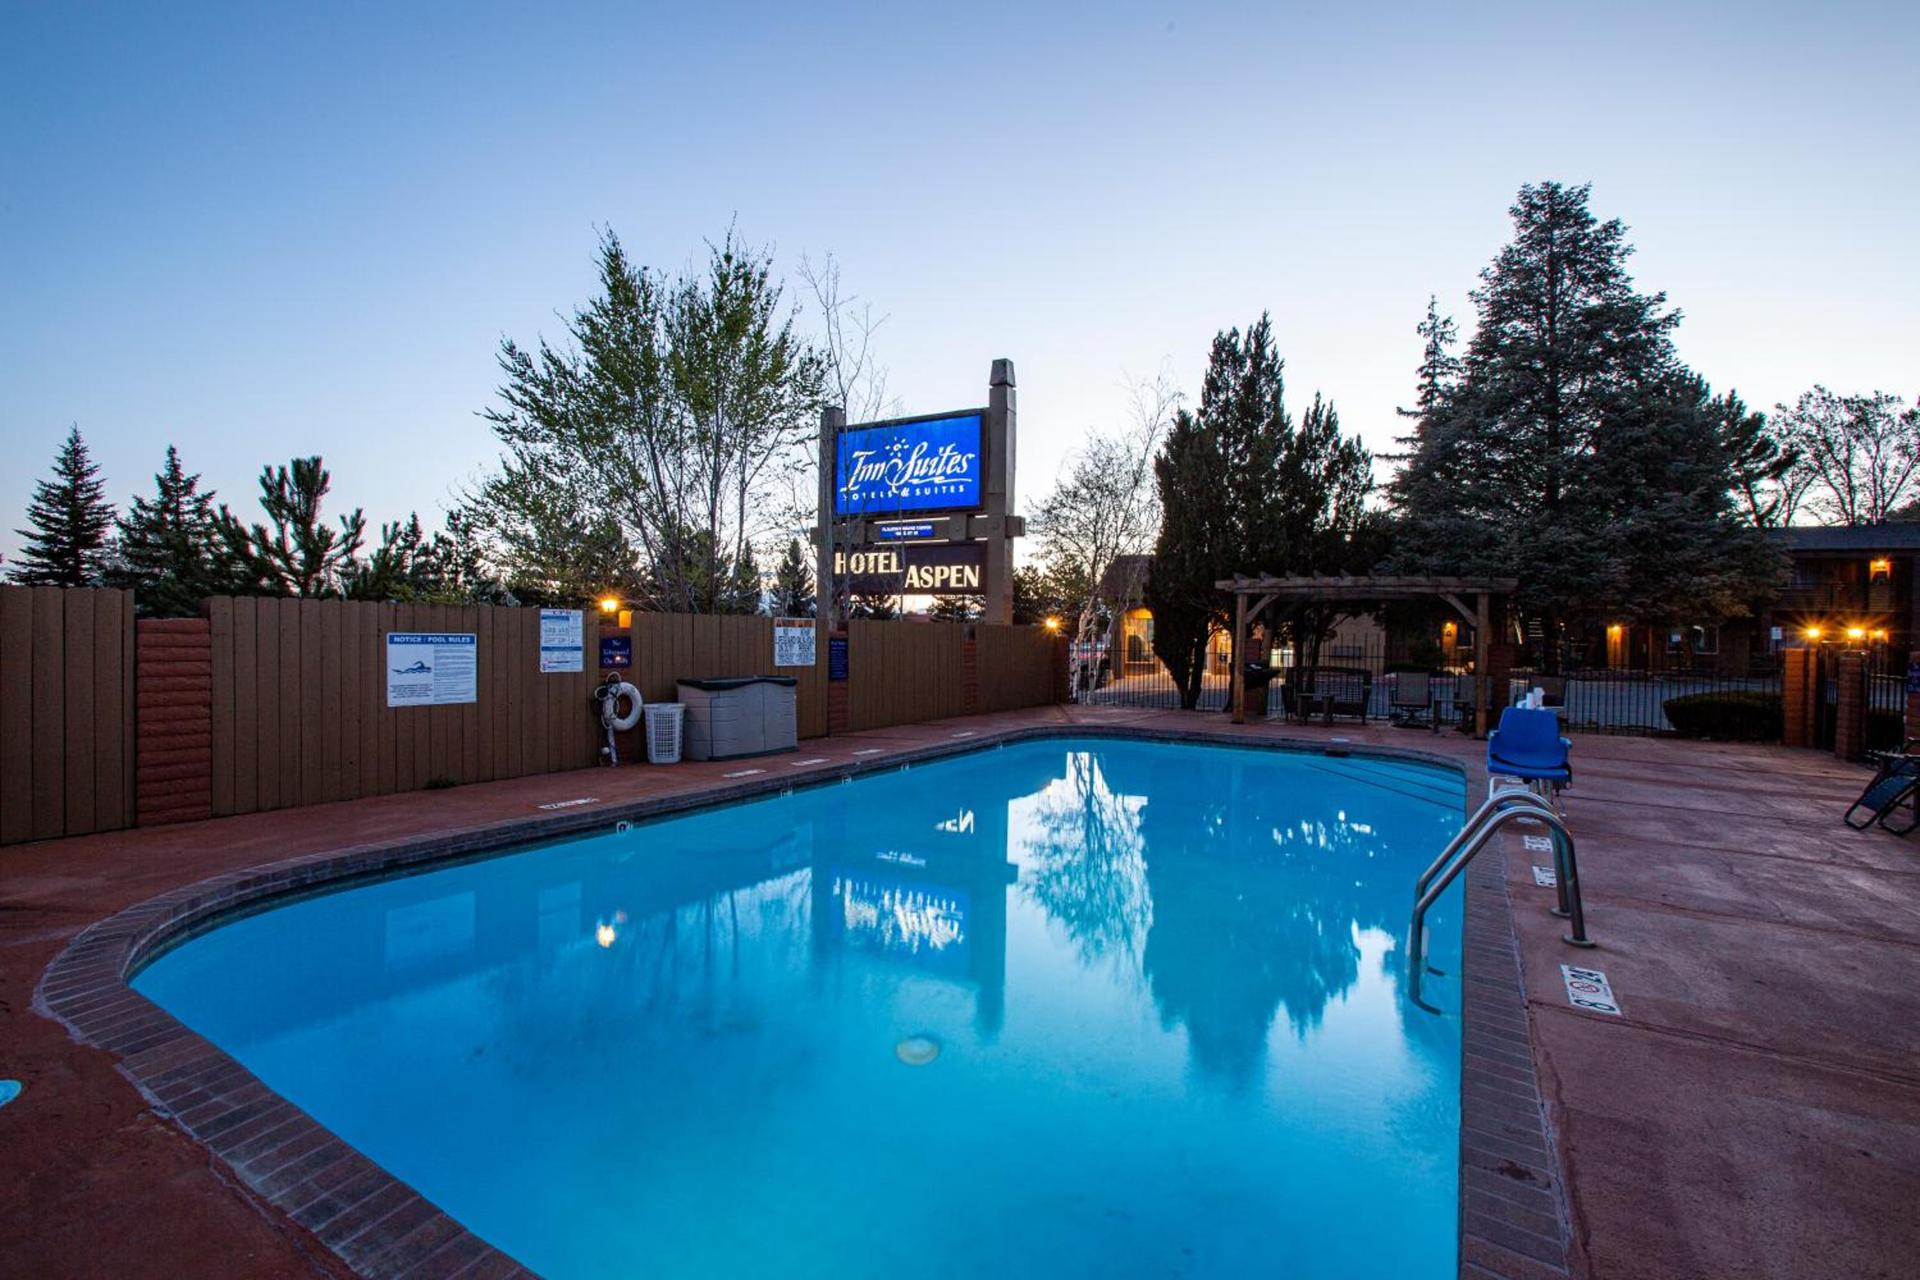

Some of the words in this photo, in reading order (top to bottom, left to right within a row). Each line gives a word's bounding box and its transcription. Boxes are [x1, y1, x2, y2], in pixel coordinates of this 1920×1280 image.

[914, 484, 965, 497] SUITES
[834, 551, 904, 575] HOTEL
[904, 564, 980, 589] ASPEN
